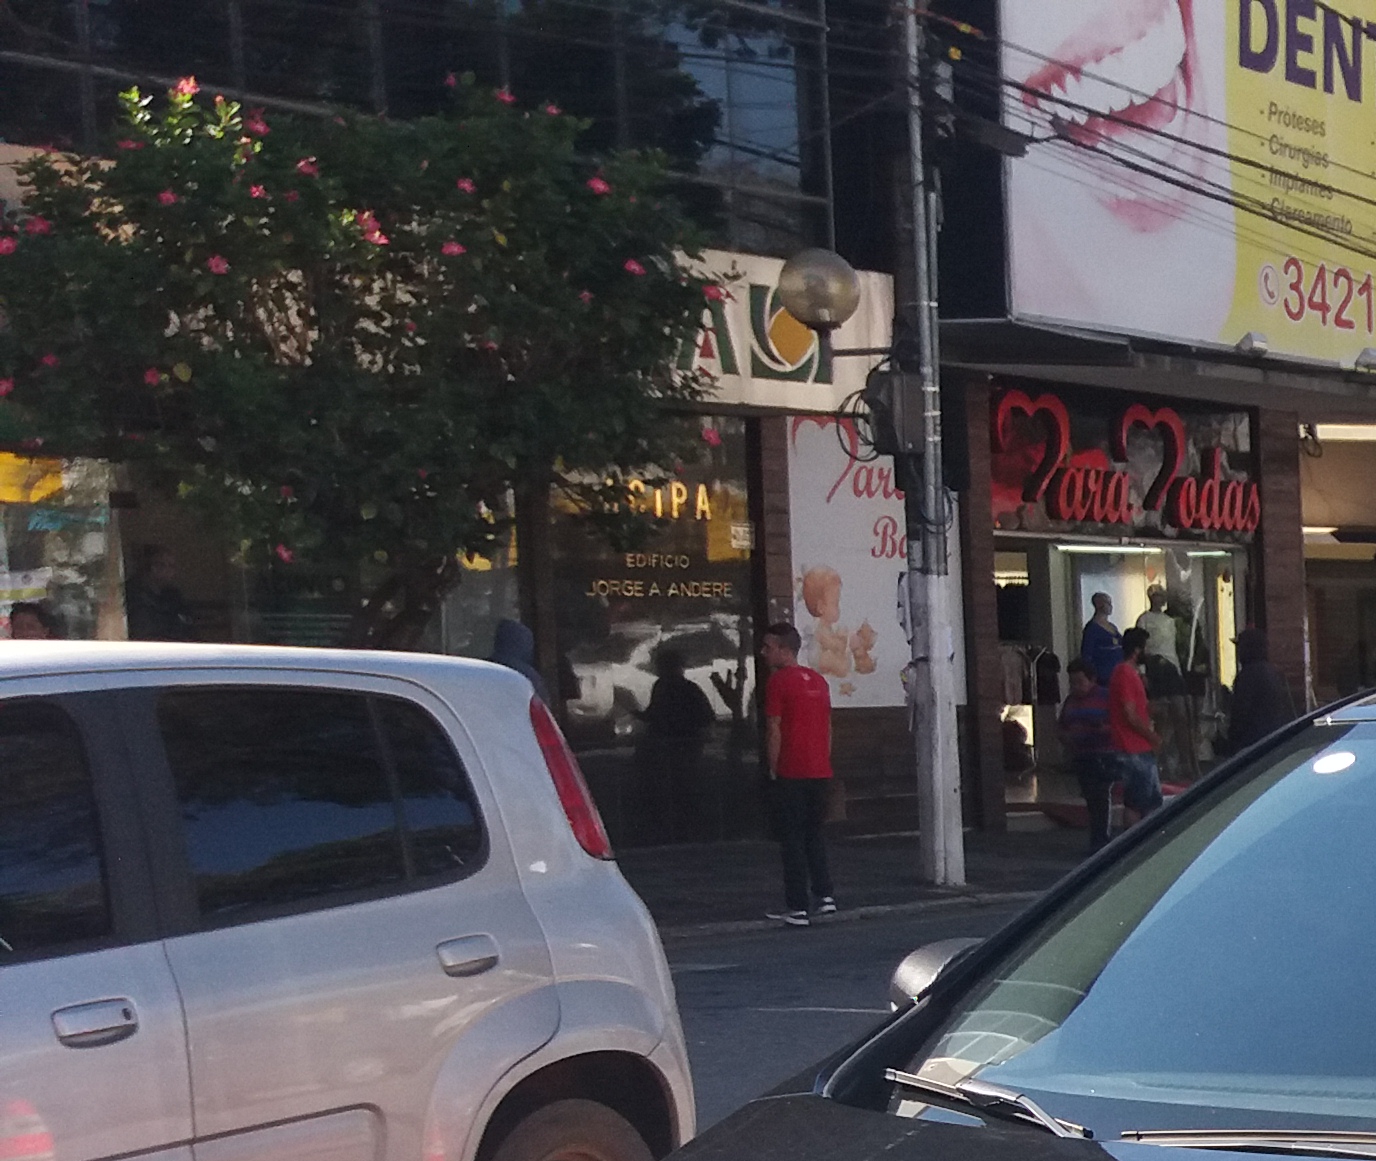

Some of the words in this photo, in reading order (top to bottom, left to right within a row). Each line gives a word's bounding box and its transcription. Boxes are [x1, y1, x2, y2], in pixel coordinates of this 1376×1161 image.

[1269, 134, 1330, 169] Cirurgias
[585, 579, 645, 598] JORGE
[667, 581, 733, 598] ANDERE
